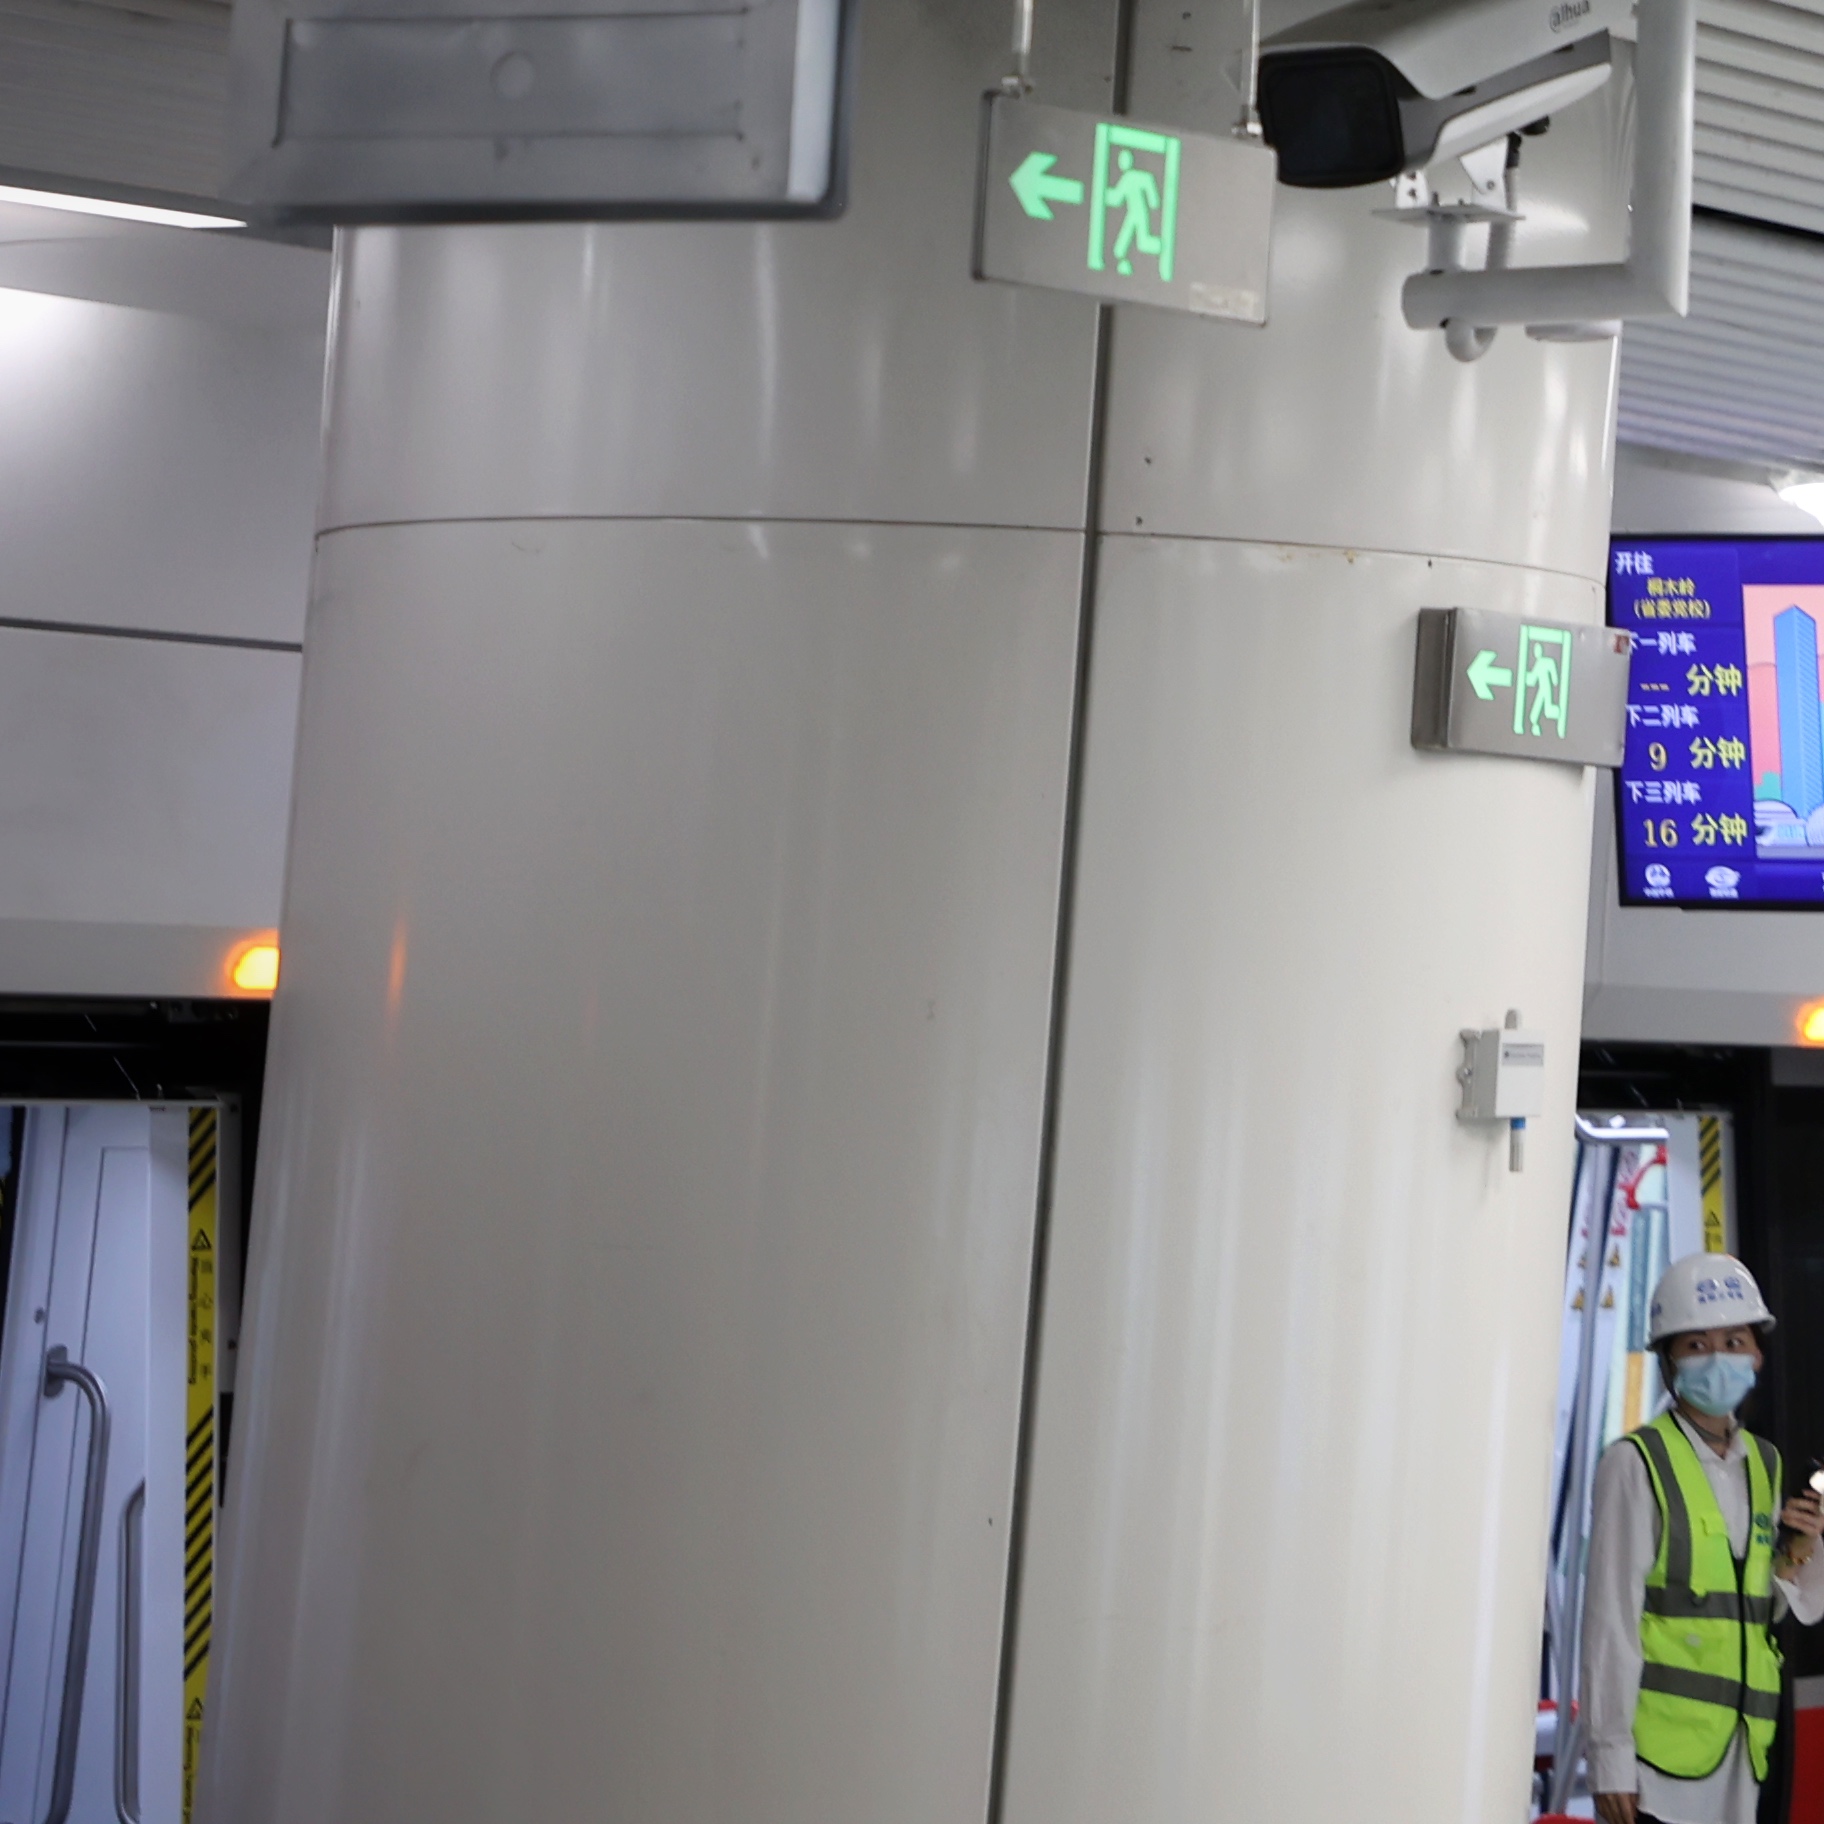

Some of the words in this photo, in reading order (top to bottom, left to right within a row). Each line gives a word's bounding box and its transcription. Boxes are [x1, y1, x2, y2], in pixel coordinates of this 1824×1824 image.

[1615, 551, 1654, 575] 开往
[1647, 576, 1696, 597] 桐木岭
[1686, 663, 1742, 696] 分钟
[1625, 703, 1700, 729] 下二列车
[1649, 741, 1667, 771] 9
[1689, 736, 1746, 770] 分钟
[1625, 779, 1701, 805] 下三列车
[1643, 818, 1679, 848] 16
[1691, 812, 1748, 846] 分钟
